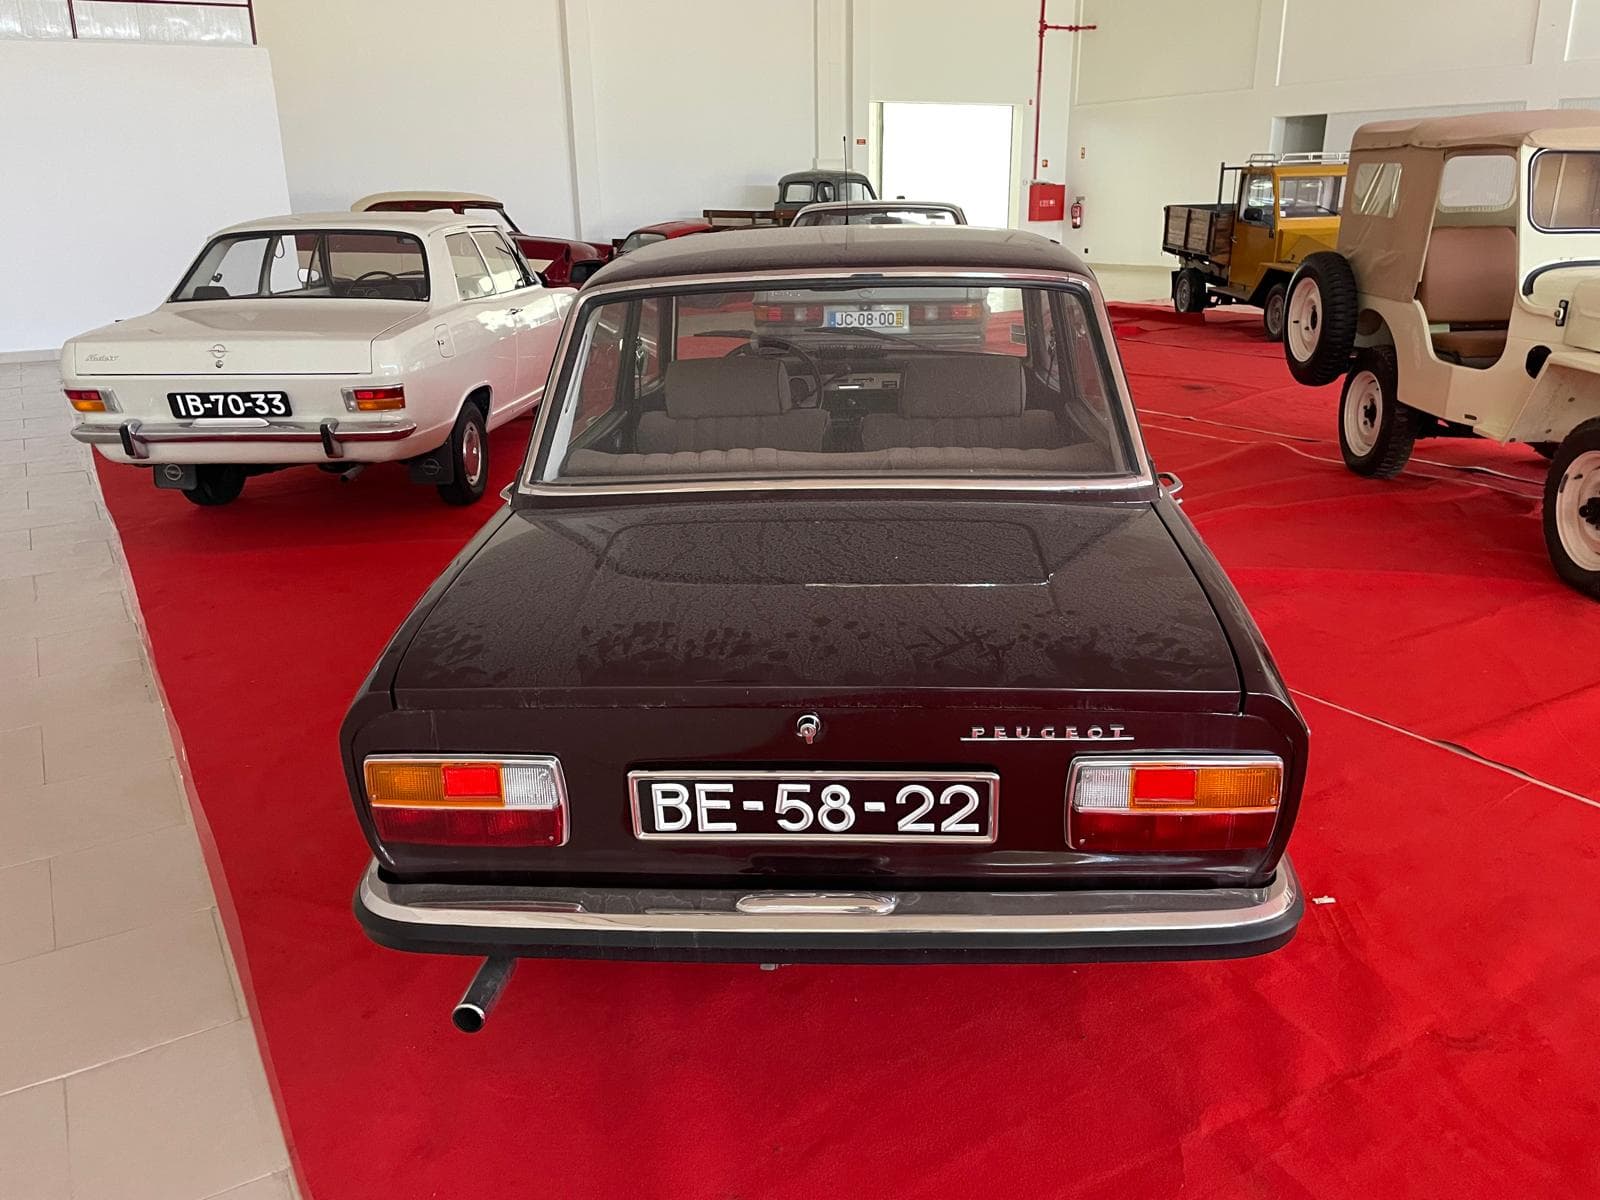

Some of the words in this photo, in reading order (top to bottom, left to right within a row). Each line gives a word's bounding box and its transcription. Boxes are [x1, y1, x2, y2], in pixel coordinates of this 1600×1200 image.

[176, 393, 286, 416] IB-70-33
[971, 725, 1125, 739] PEUGEOT
[651, 783, 980, 832] BE-58-22
